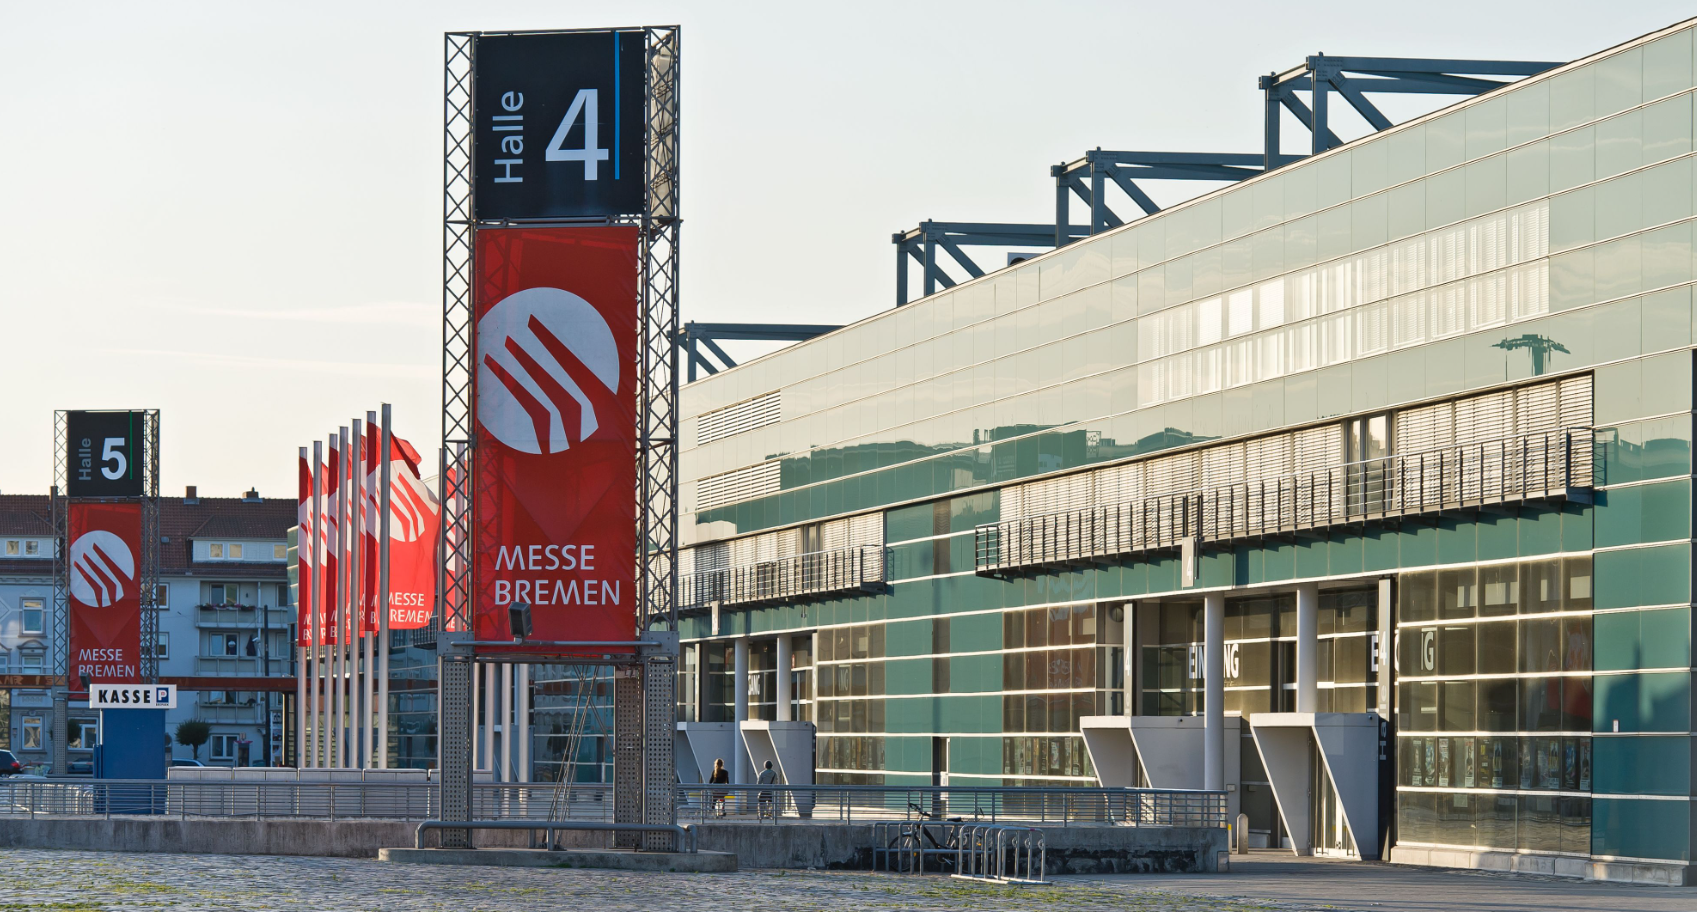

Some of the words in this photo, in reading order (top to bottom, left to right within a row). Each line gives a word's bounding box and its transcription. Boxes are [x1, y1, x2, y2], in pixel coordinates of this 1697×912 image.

[492, 90, 524, 183] Halle
[545, 88, 609, 181] 4
[79, 437, 92, 481] Halle
[101, 437, 127, 480] 5
[495, 544, 595, 571] MESSE
[1186, 556, 1192, 580] 4
[495, 579, 620, 605] BREMEN
[390, 609, 433, 623] REMEN
[78, 648, 123, 661] MESSE
[1125, 646, 1130, 676] 4
[1189, 643, 1239, 679] EINNG
[1380, 631, 1387, 665] 4
[78, 664, 135, 677] BREMEN
[98, 689, 151, 704] KASSE
